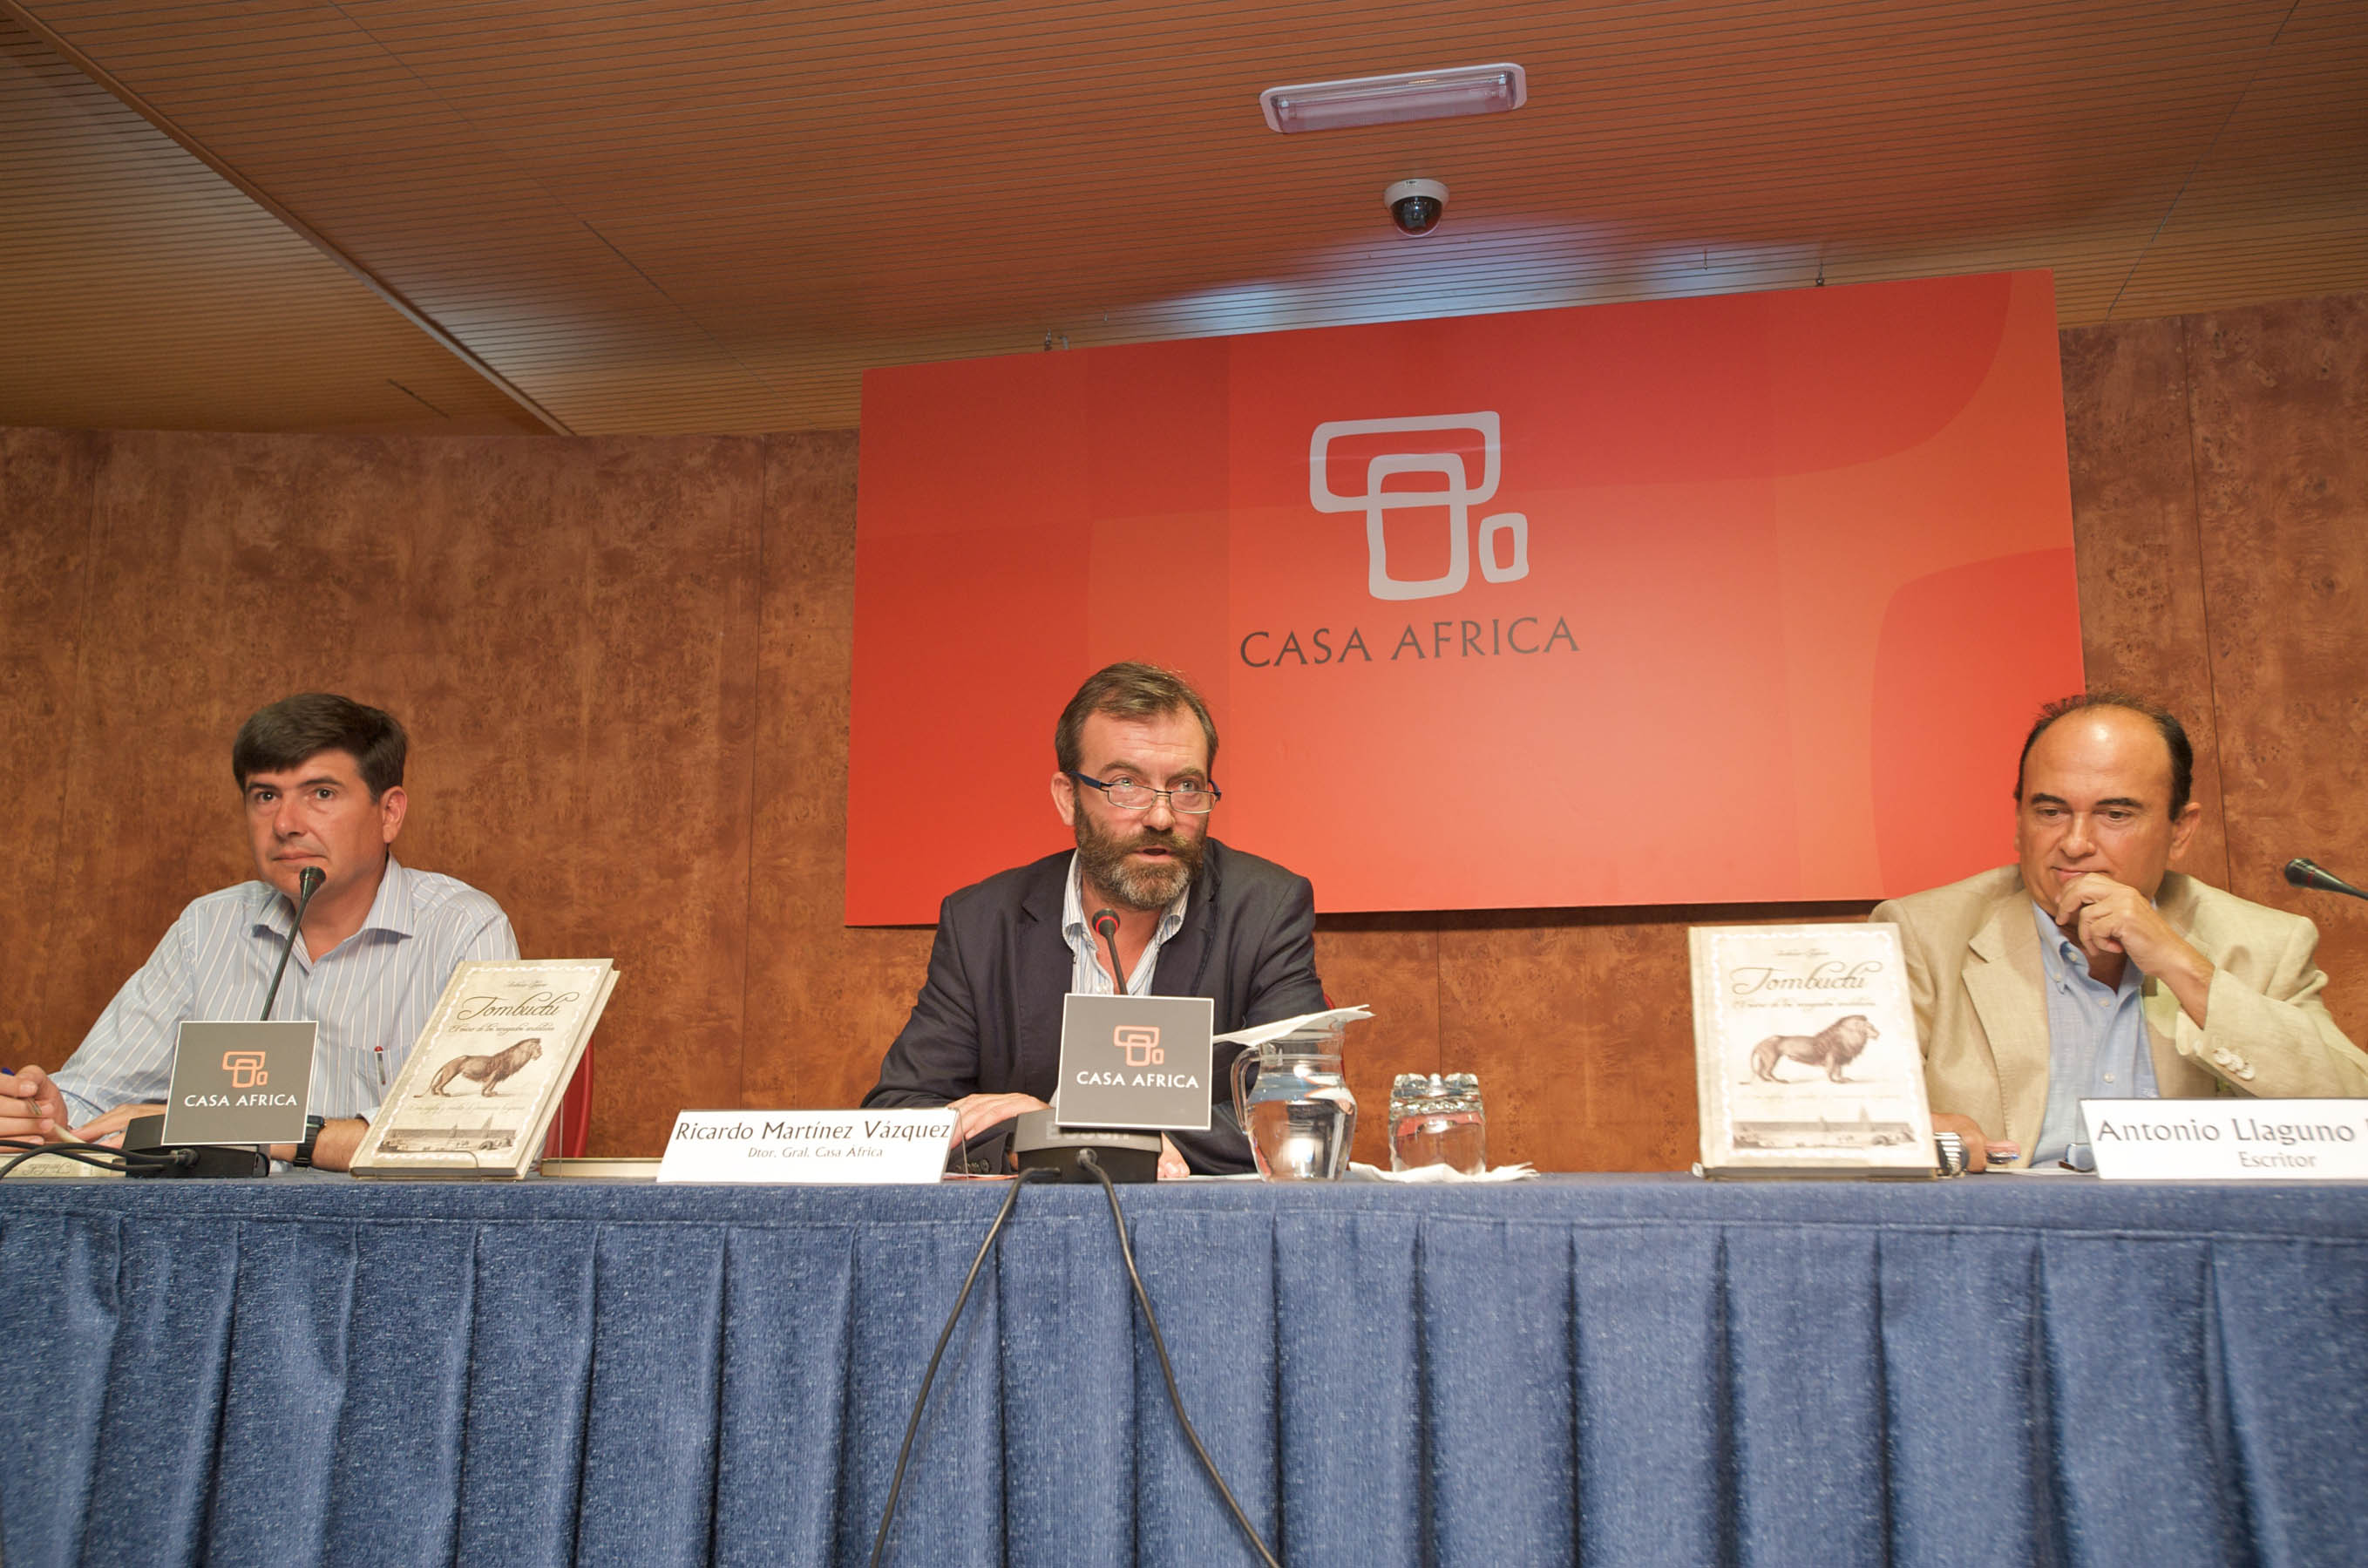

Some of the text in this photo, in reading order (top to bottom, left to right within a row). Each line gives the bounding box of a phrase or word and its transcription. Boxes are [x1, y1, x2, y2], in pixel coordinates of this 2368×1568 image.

[1240, 615, 1581, 669] CASA AFRICA
[1076, 1070, 1199, 1089] CASA AFRICA
[184, 1094, 297, 1107] CASA AFRICA
[675, 1120, 951, 1141] Ricardo Martínez Vázquez
[2097, 1118, 2221, 1142] Antonio
[2231, 1117, 2356, 1146] Llaguno
[748, 1144, 883, 1158] Dtor. Gral. Casa África
[2237, 1151, 2317, 1168] Escritor
